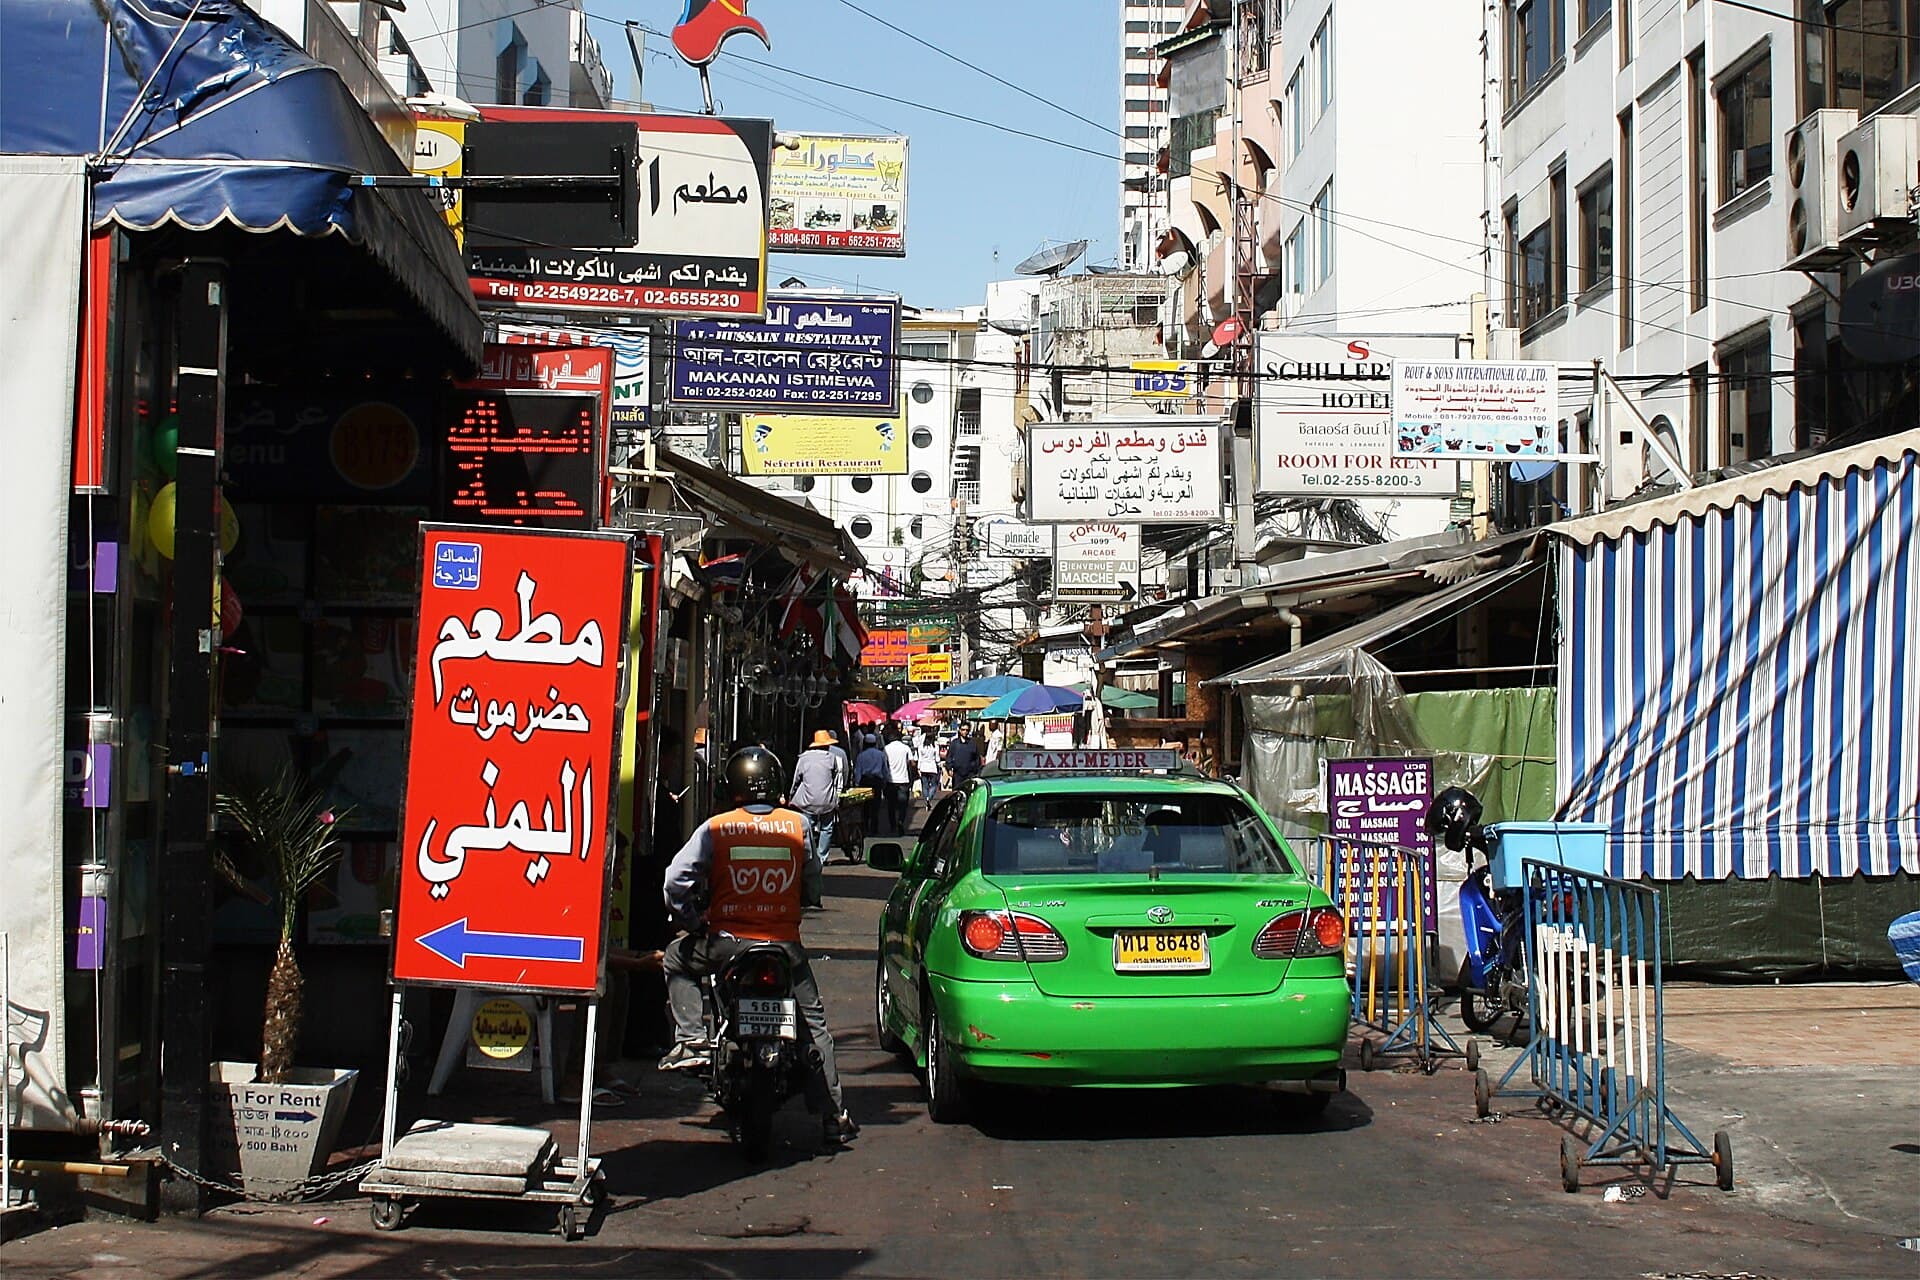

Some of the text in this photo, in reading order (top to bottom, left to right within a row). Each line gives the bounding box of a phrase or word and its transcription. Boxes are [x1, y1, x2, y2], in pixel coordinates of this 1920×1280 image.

[673, 172, 747, 216] مطعم
[826, 234, 840, 245] Fax
[669, 264, 700, 286] لكم
[704, 266, 748, 288] يقدم
[489, 282, 740, 308] Tel: 02-2549226-7, 02-6555230
[688, 329, 882, 347] AL-HUSSAIN RESTAURANT
[1347, 340, 1370, 360] S
[688, 371, 875, 388] MAKANAN ISTIMEWA
[1404, 366, 1424, 379] ROUF
[1426, 366, 1433, 379] &
[1434, 367, 1453, 380] SONS
[1456, 367, 1515, 381] INTERNATIONAL
[682, 386, 882, 401] Tel: 02-252-0240 Fax: 02-251-7295
[1298, 421, 1350, 437] ชิลเลอร์ส
[1353, 421, 1381, 437] อินน์
[1041, 430, 1110, 453] الفردوس
[1170, 428, 1208, 453] فندق
[229, 443, 287, 465] enu
[1091, 453, 1159, 466] يرحب بكم
[1277, 454, 1440, 470] ROOM FOR RENT
[764, 459, 883, 468] Nefertiti Restaurant
[1148, 466, 1160, 483] لكم
[1163, 466, 1192, 483] ويقدم
[1302, 474, 1422, 487] Tel.02-255-8200-3
[1058, 483, 1099, 504] اللبنانية
[1107, 502, 1142, 517] حلال
[1005, 530, 1040, 548] pinnacle
[1069, 522, 1128, 543] FORTUNA
[438, 547, 478, 564] أسماك
[1059, 561, 1137, 572] BIENVENUE AU
[435, 565, 478, 586] طازجة
[1061, 573, 1115, 583] MARCHE
[1058, 588, 1130, 596] Wholesale market
[431, 569, 604, 711] مطعم
[450, 685, 591, 743] حضرموت
[1032, 751, 1149, 768] TAXI-METER
[1335, 772, 1427, 797] MASSAGE
[1337, 796, 1424, 818] مساج
[417, 756, 593, 902] اليمني
[719, 815, 795, 836] เขตวัฒนา
[1336, 818, 1351, 829] OIL
[1361, 817, 1399, 829] MASSAGE
[1361, 832, 1400, 844] MASSAGE
[1341, 847, 1359, 859] OT
[1364, 847, 1399, 859] ASAE
[728, 856, 796, 894] ๒๗
[1120, 934, 1200, 952] ทน 8648
[245, 1091, 275, 1105] For
[280, 1093, 321, 1107] Rent
[246, 1141, 267, 1151] 500
[270, 1142, 298, 1152] Baht
